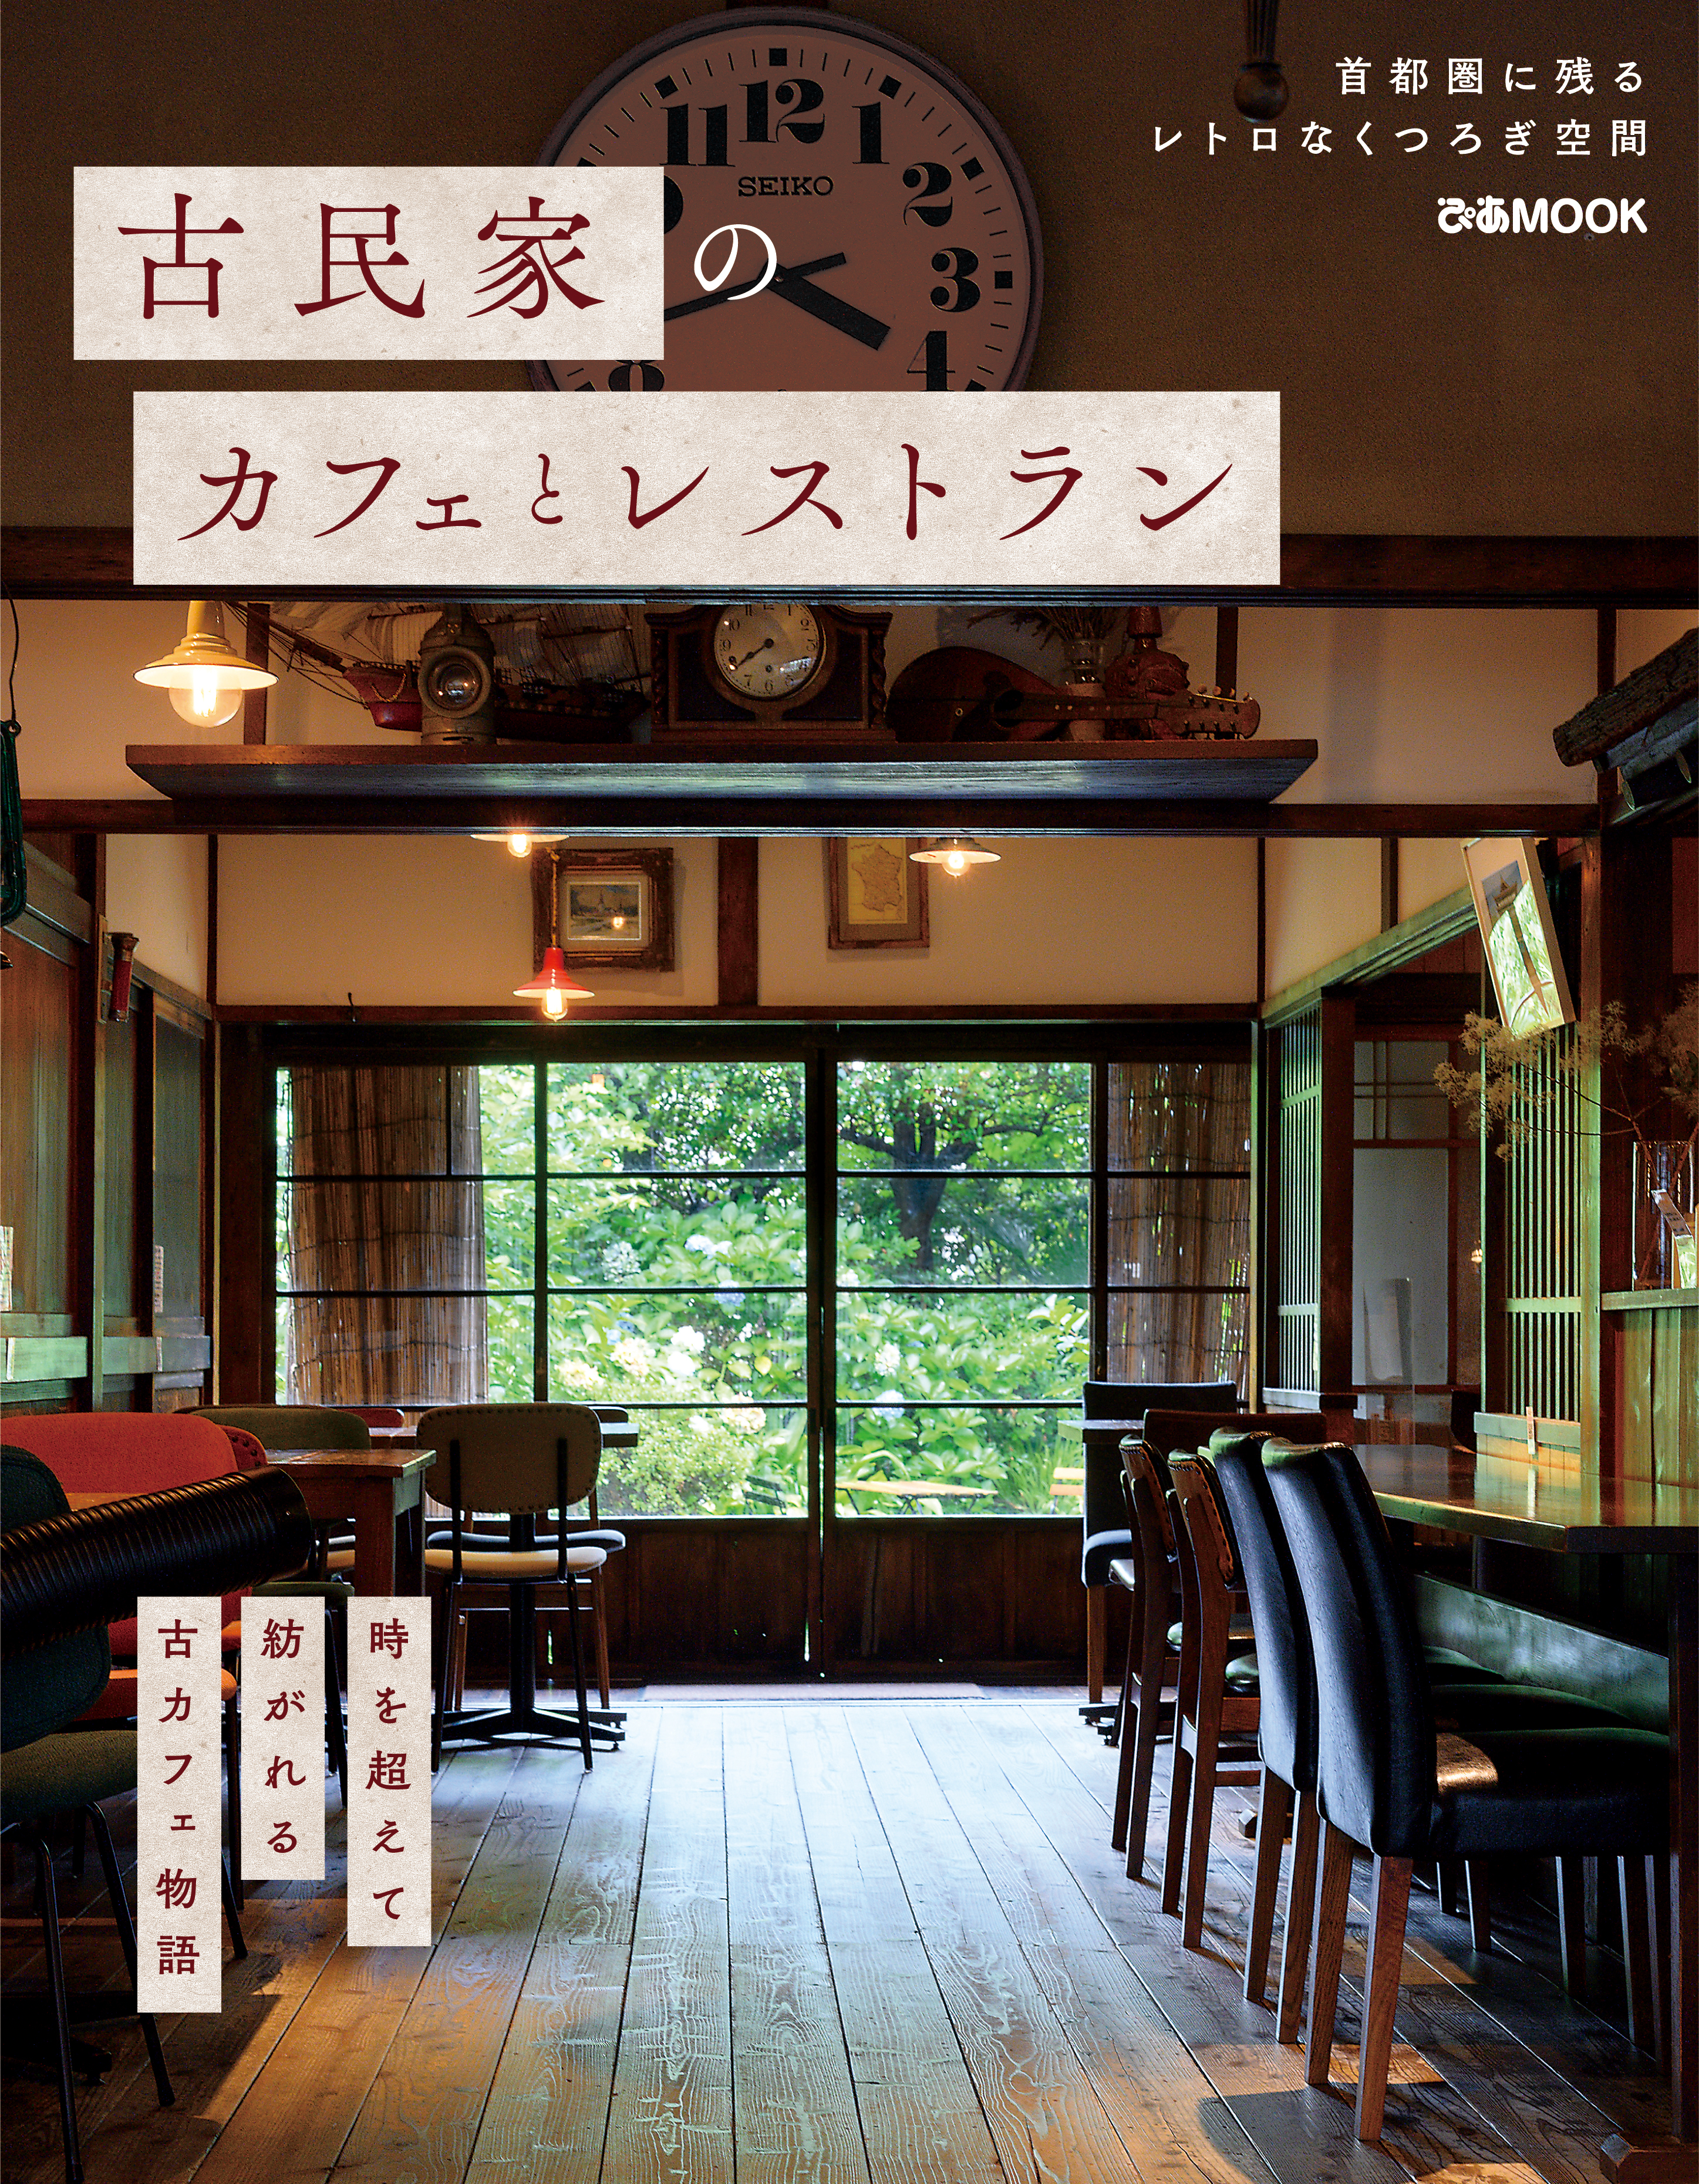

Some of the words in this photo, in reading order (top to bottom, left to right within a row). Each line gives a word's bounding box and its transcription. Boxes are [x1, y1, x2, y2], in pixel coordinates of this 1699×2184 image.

[660, 103, 736, 167] 11
[739, 79, 825, 144] 12
[852, 102, 891, 164] 1
[738, 176, 834, 197] SEIKO
[902, 162, 954, 227] 2
[930, 247, 981, 312] 3
[906, 331, 956, 392] 4
